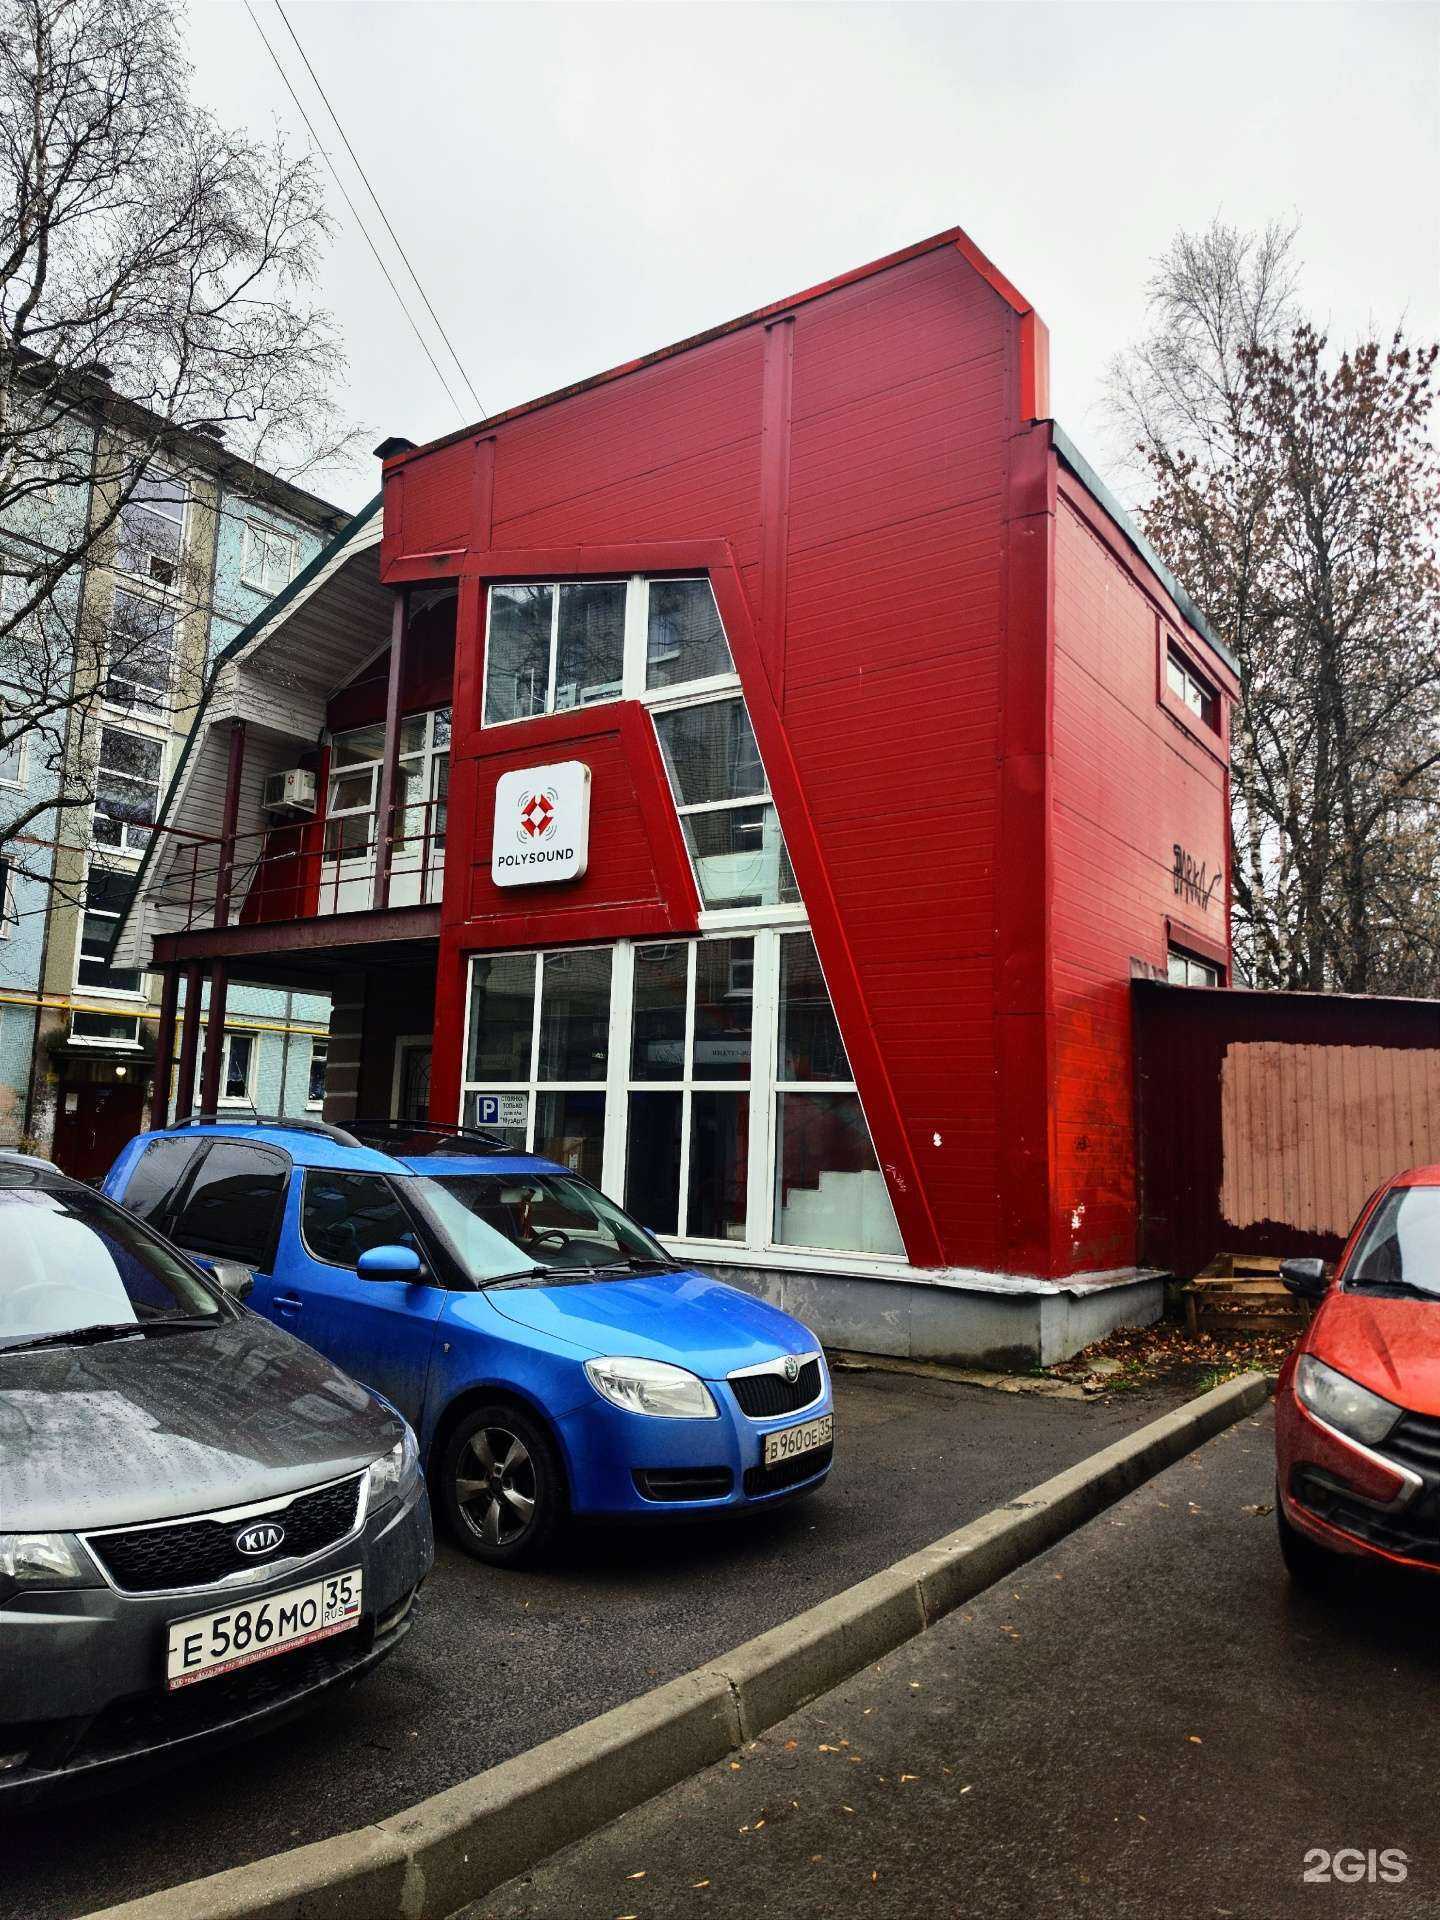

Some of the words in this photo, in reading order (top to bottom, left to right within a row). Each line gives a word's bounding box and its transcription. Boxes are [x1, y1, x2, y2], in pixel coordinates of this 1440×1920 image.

[498, 848, 574, 867] POLYSOUND
[483, 1099, 496, 1121] P
[819, 1418, 830, 1436] 35
[245, 1529, 279, 1551] KIA
[326, 1575, 353, 1610] 35
[324, 1607, 344, 1622] RUS
